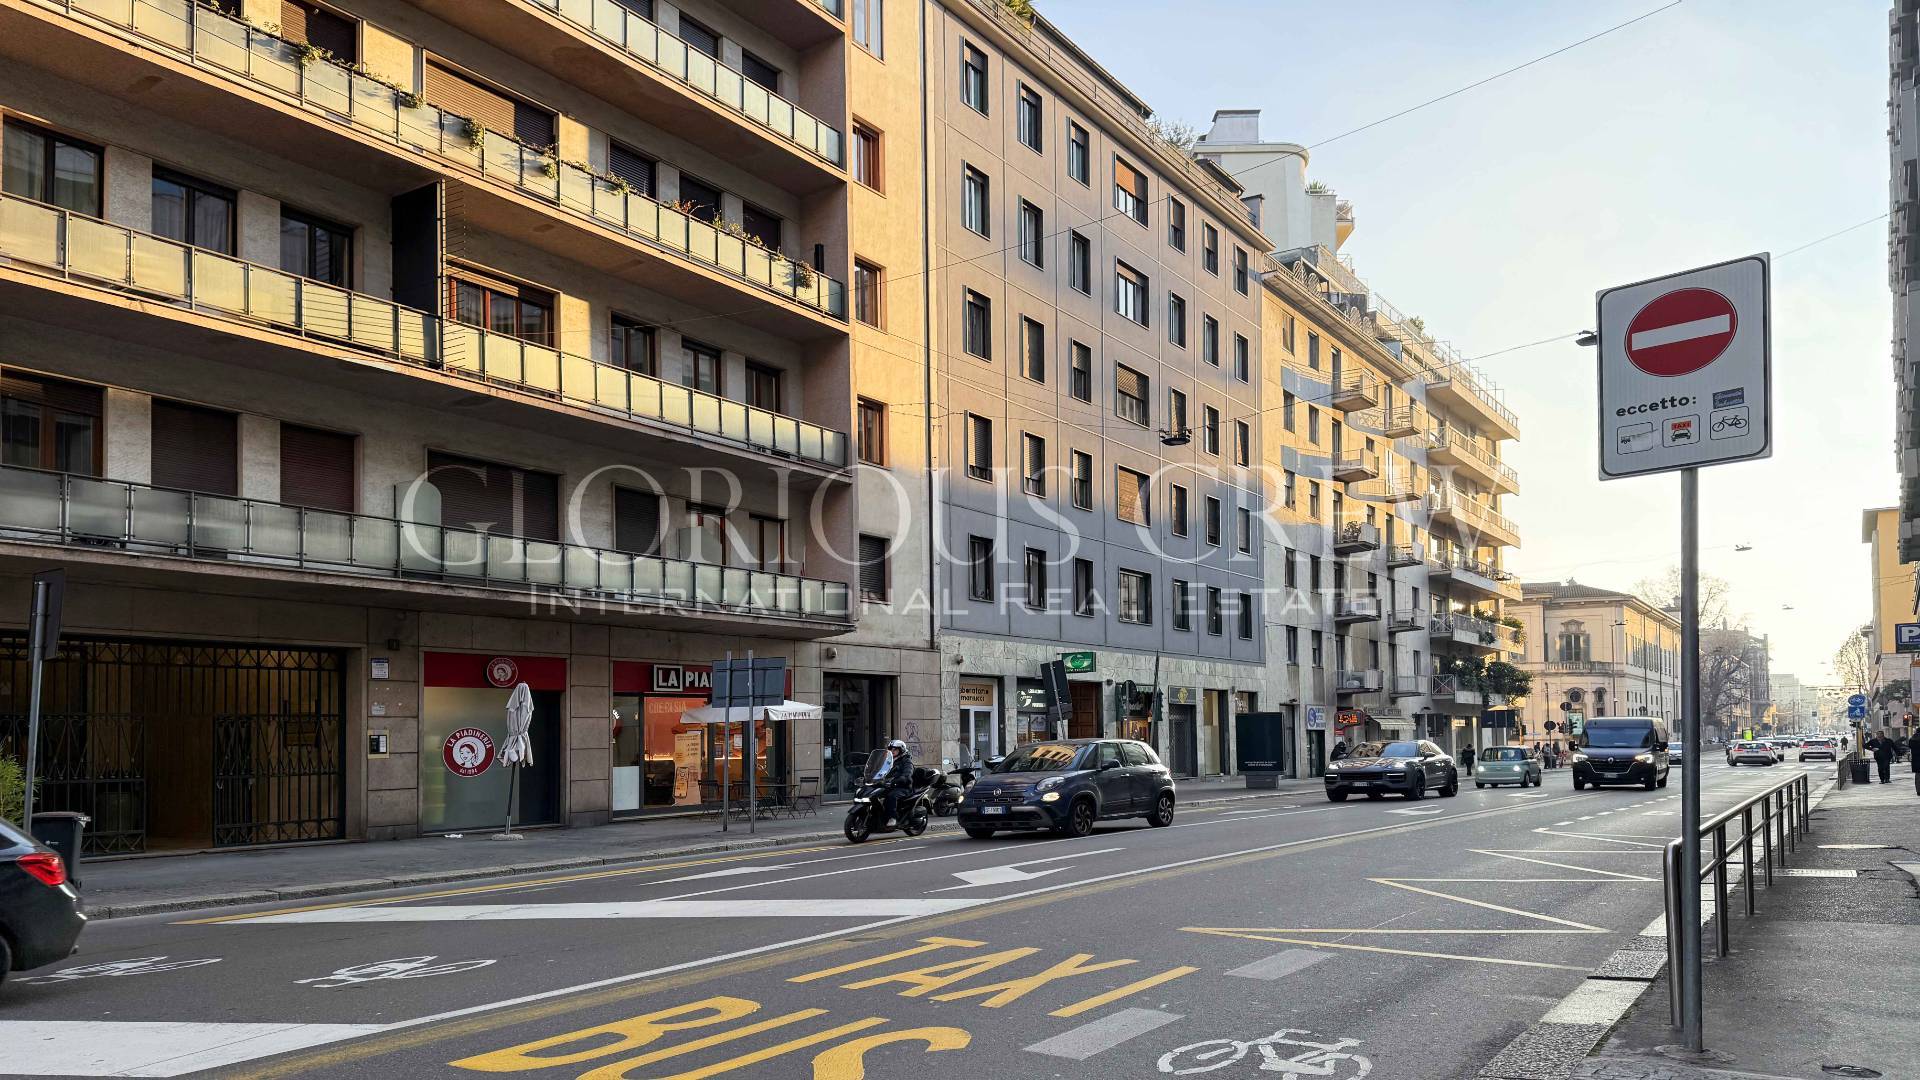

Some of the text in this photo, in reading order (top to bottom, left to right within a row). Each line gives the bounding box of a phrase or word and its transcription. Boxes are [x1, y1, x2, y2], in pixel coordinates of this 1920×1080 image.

[1615, 396, 1697, 417] eccetto:
[1671, 421, 1692, 430] TAXI
[658, 669, 712, 688] LA PIA
[447, 729, 492, 749] LA PIADINERIA
[785, 936, 1202, 1018] TAXI
